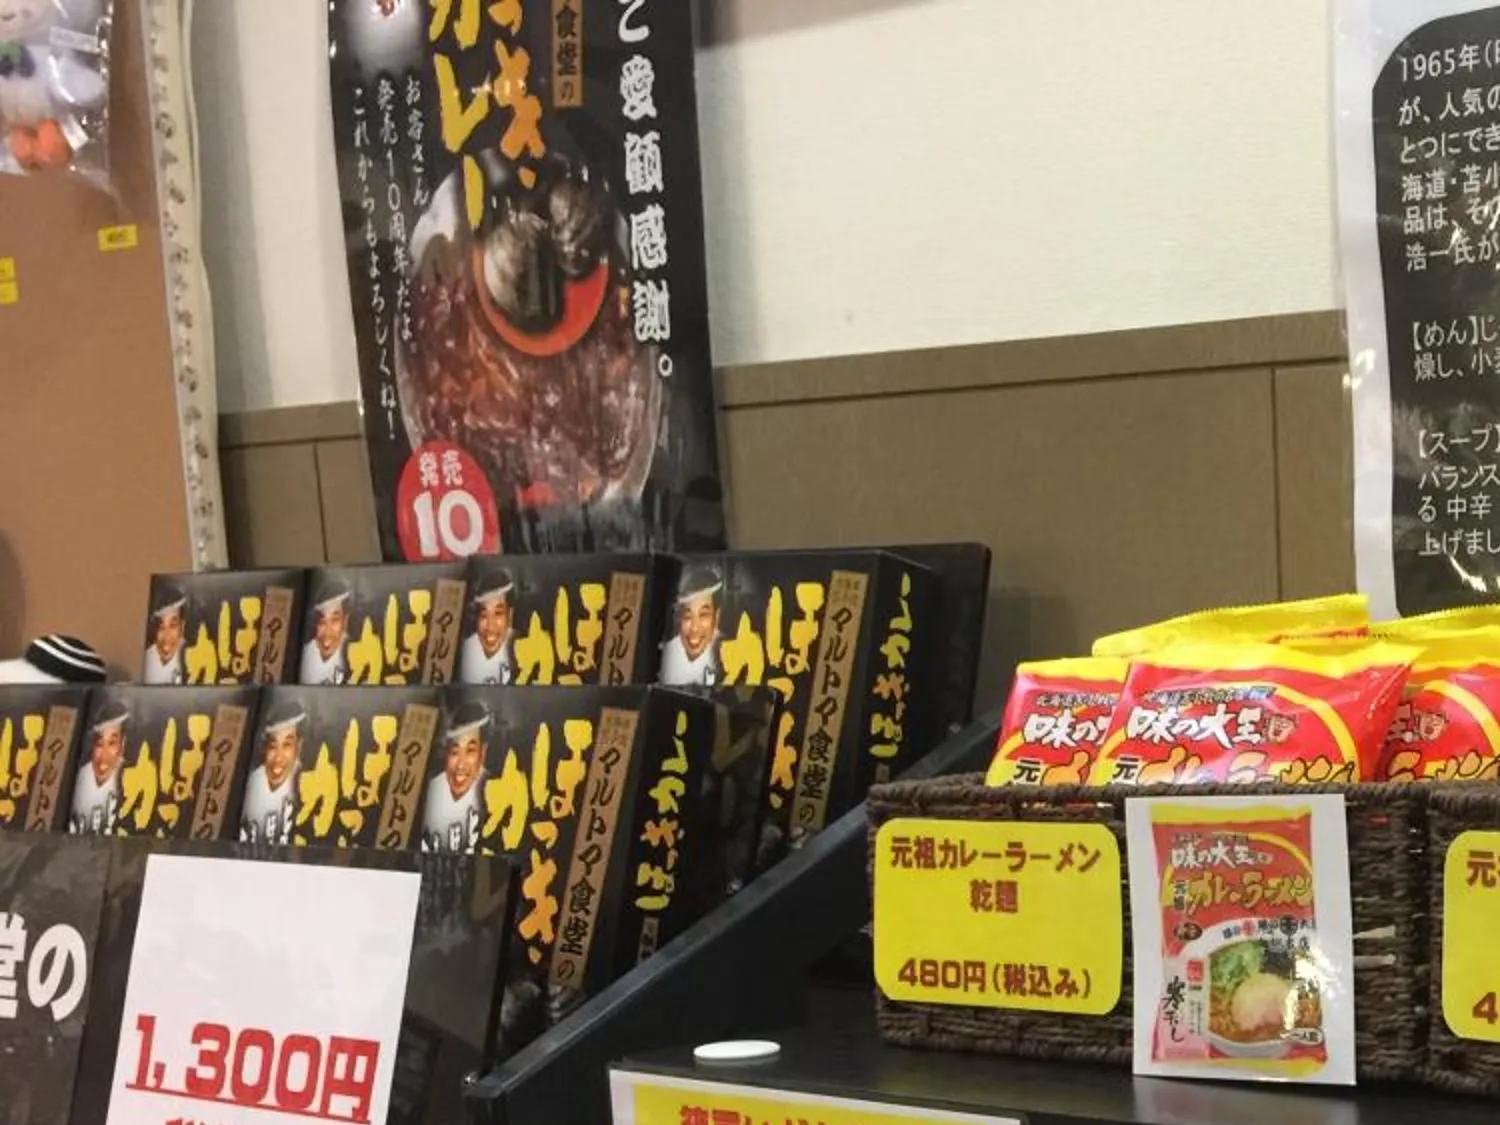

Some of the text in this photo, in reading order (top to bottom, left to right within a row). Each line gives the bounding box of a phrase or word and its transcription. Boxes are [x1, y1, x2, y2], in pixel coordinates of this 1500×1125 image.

[414, 491, 485, 558] 10
[1125, 703, 1264, 749] 味の大王
[889, 836, 1102, 875] 元祖カレーラーメン
[969, 879, 1019, 914] 乾麺
[898, 956, 1093, 1000] 480円(税込み)
[133, 1013, 381, 1123] 1,300円
